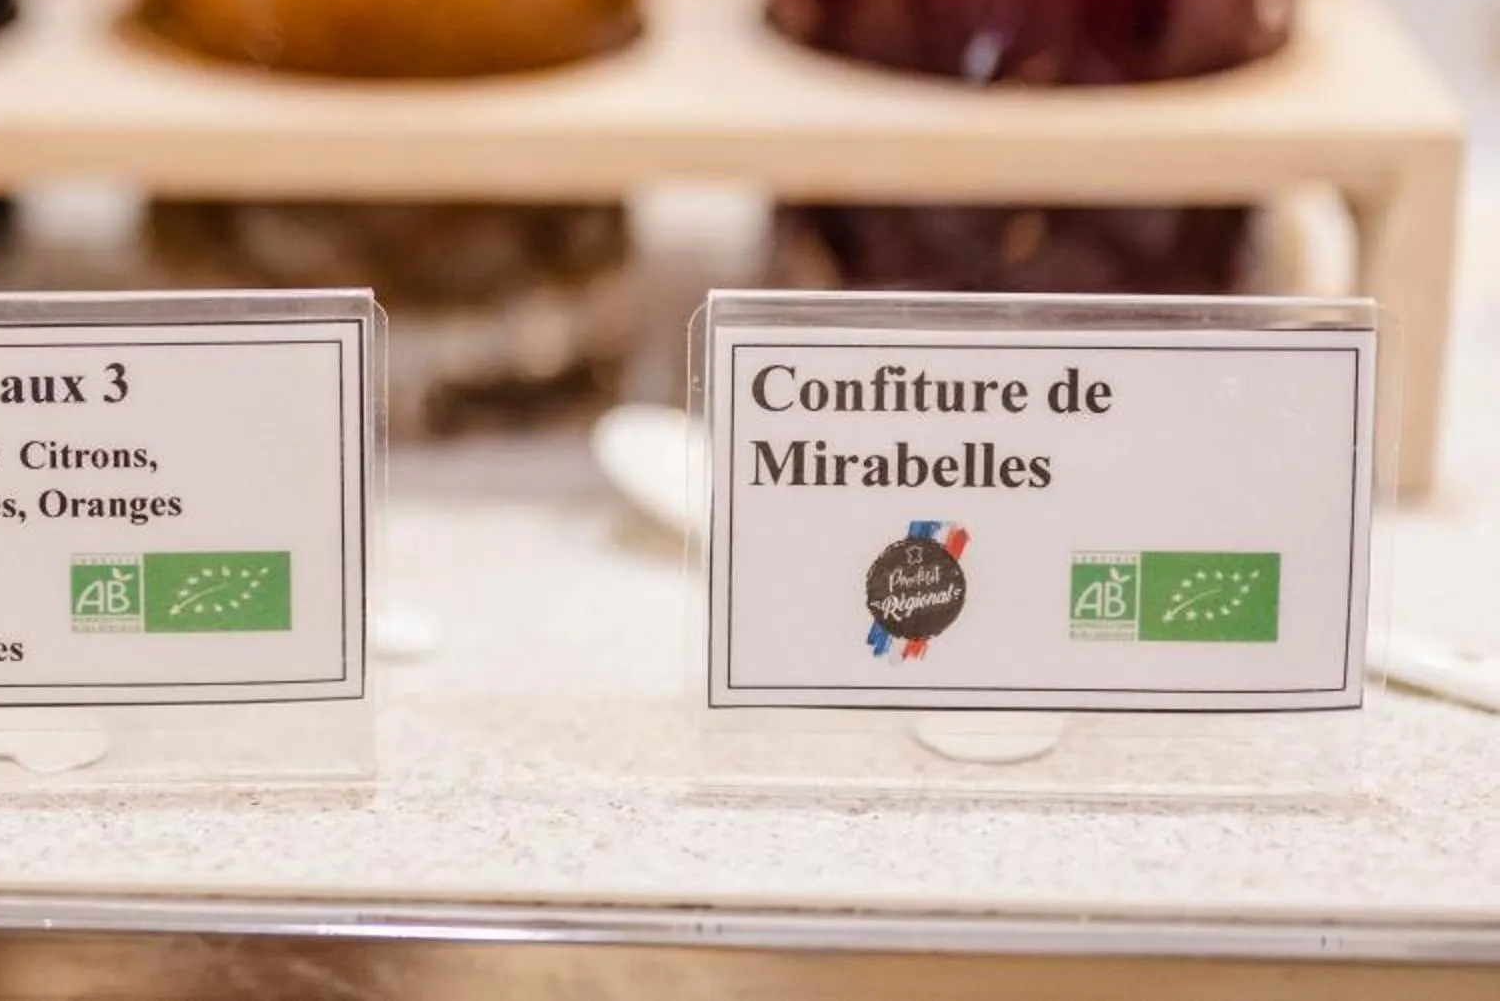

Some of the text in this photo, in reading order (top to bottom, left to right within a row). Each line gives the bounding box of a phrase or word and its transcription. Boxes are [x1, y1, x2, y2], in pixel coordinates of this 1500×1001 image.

[0, 375, 87, 405] aux
[102, 361, 130, 405] 3
[750, 363, 1113, 414] Confiture de
[18, 439, 159, 474] Citrons,
[749, 439, 1052, 489] Mirabelles
[37, 488, 184, 526] Oranges
[77, 579, 130, 614] AB
[1074, 580, 1127, 618] AB
